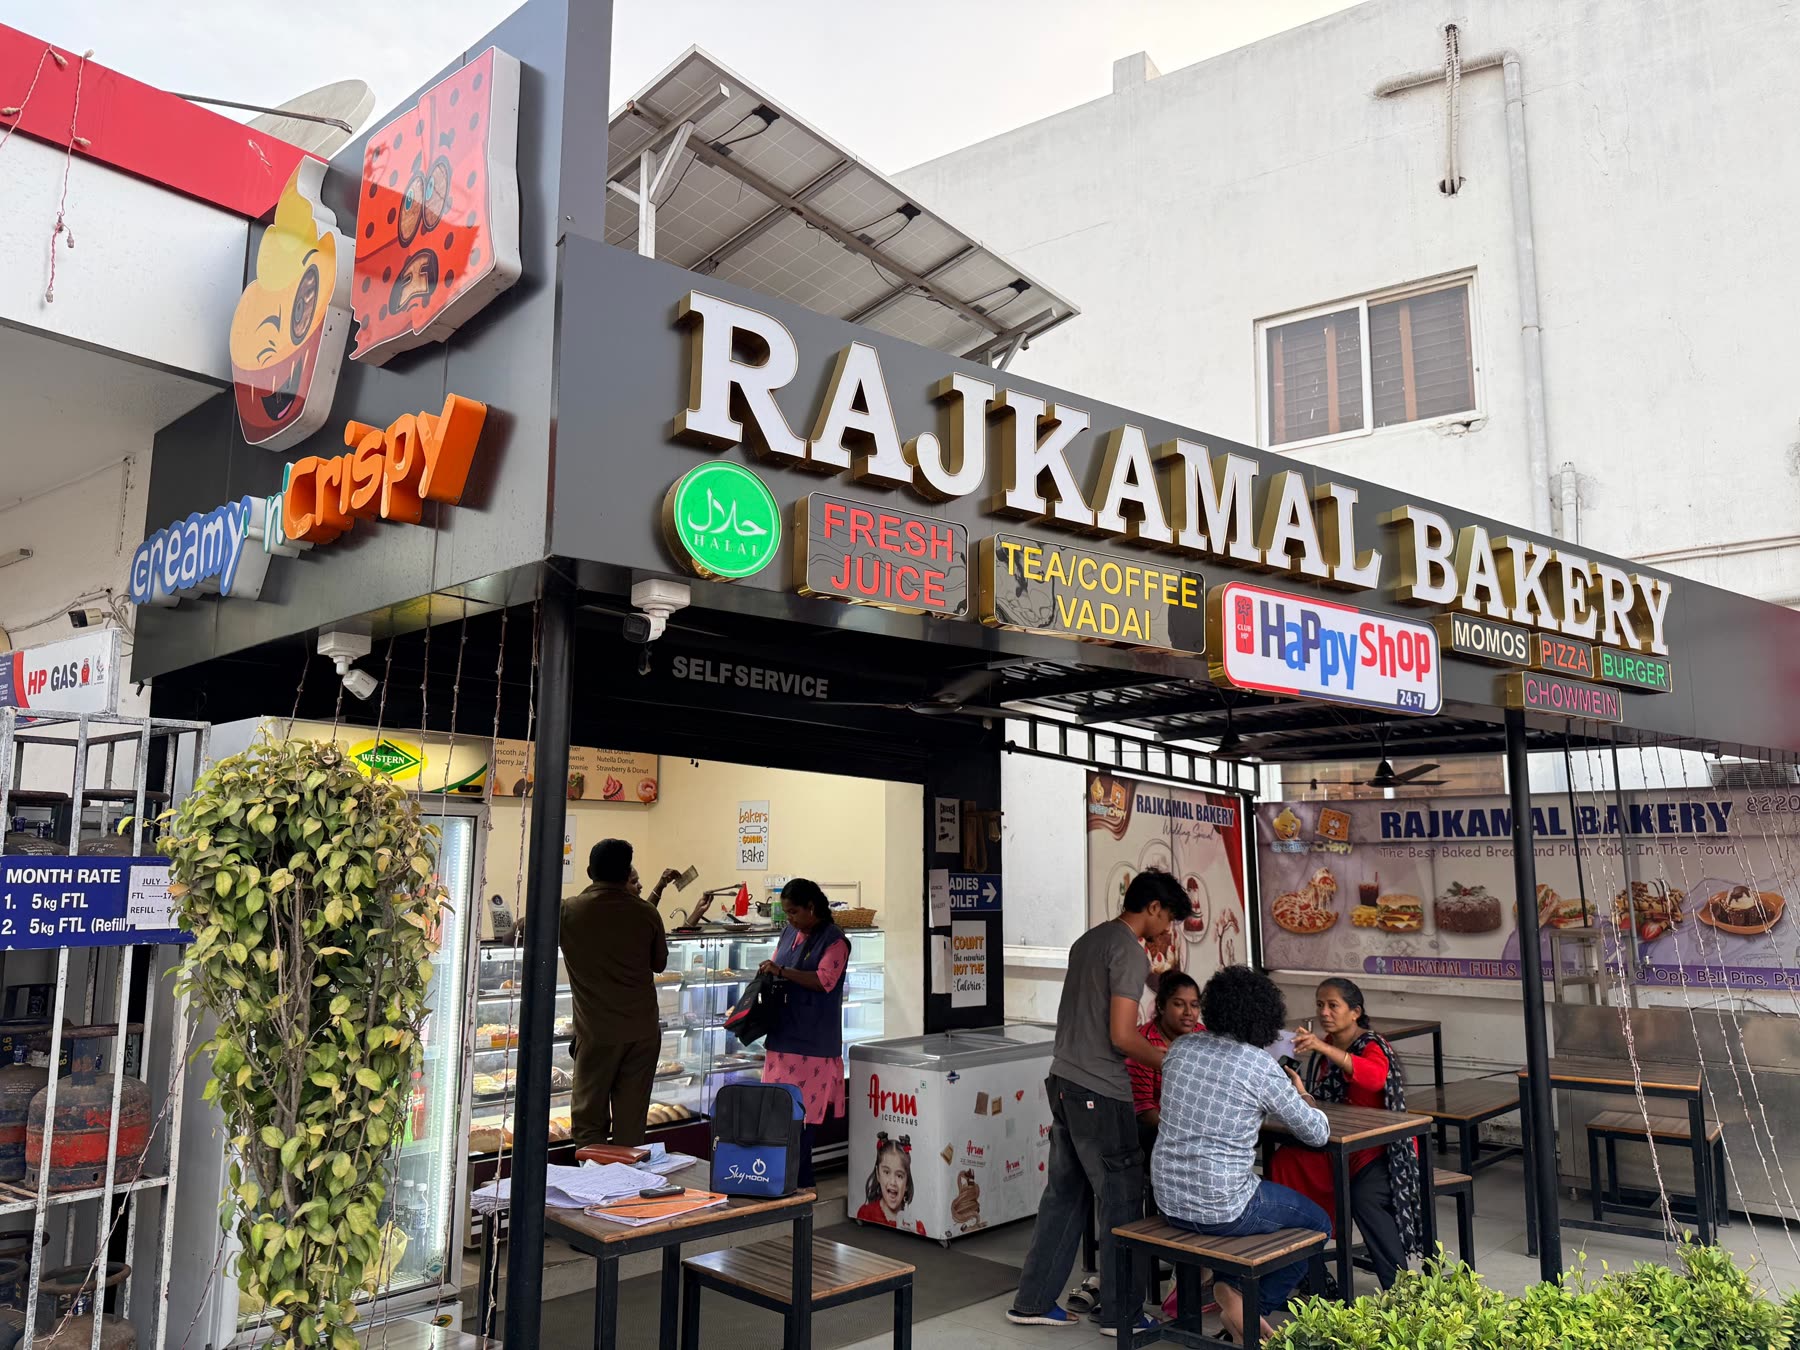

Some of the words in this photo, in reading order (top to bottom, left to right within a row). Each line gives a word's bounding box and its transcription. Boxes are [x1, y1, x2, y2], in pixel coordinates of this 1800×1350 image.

[684, 289, 1382, 589] RAJKAMAL
[1406, 504, 1673, 656] BAKERY
[687, 487, 768, 536] حلال
[823, 501, 954, 563] FRESH
[693, 533, 760, 557] HALAL
[830, 554, 946, 607] JUICE
[1001, 540, 1198, 609] TEA/COFFEE
[1057, 594, 1151, 641] VADAI
[1237, 623, 1252, 633] CLUB
[1240, 632, 1249, 640] HP
[1454, 619, 1527, 660] MOMOS
[1542, 640, 1589, 672] PIZZA
[28, 669, 47, 696] HP
[51, 662, 78, 692] GAS
[1603, 653, 1667, 687] BURGER
[1526, 678, 1617, 717] CHOWMEIN
[361, 753, 405, 765] WESTERN
[596, 755, 617, 764] Nutella
[617, 757, 635, 765] Donut
[596, 764, 626, 774] Strawberry
[632, 767, 649, 775] Donut
[739, 808, 768, 824] bakers
[1136, 794, 1194, 820] RAJKAMAL
[1196, 804, 1235, 826] BAKERY
[1577, 801, 1733, 835] BAKERY
[1380, 847, 1404, 858] The
[1408, 846, 1436, 858] Best
[1442, 845, 1481, 858] Baked
[1636, 843, 1656, 855] In
[1659, 843, 1688, 855] The
[1693, 843, 1736, 855] Town
[6, 868, 73, 884] MONTH
[77, 868, 121, 884] RATE
[949, 877, 979, 890] ADIES
[4, 893, 17, 910] 1.
[60, 892, 89, 909] FTL
[950, 894, 979, 908] OILET
[0, 918, 17, 935] 2.
[58, 917, 86, 933] FTL
[953, 936, 985, 950] COUNT
[953, 963, 969, 976] NOT
[969, 963, 985, 975] THE
[1392, 959, 1464, 976] RAJKAMAL
[1469, 962, 1517, 977] FUELS
[1656, 969, 1692, 984] Opp.
[1731, 971, 1768, 987] Pins,
[867, 1073, 918, 1118] Arun
[881, 1113, 919, 1127] ICECREAMS
[966, 1139, 984, 1156] Arun
[724, 1164, 746, 1184] Sky
[1006, 1159, 1020, 1173] Arun
